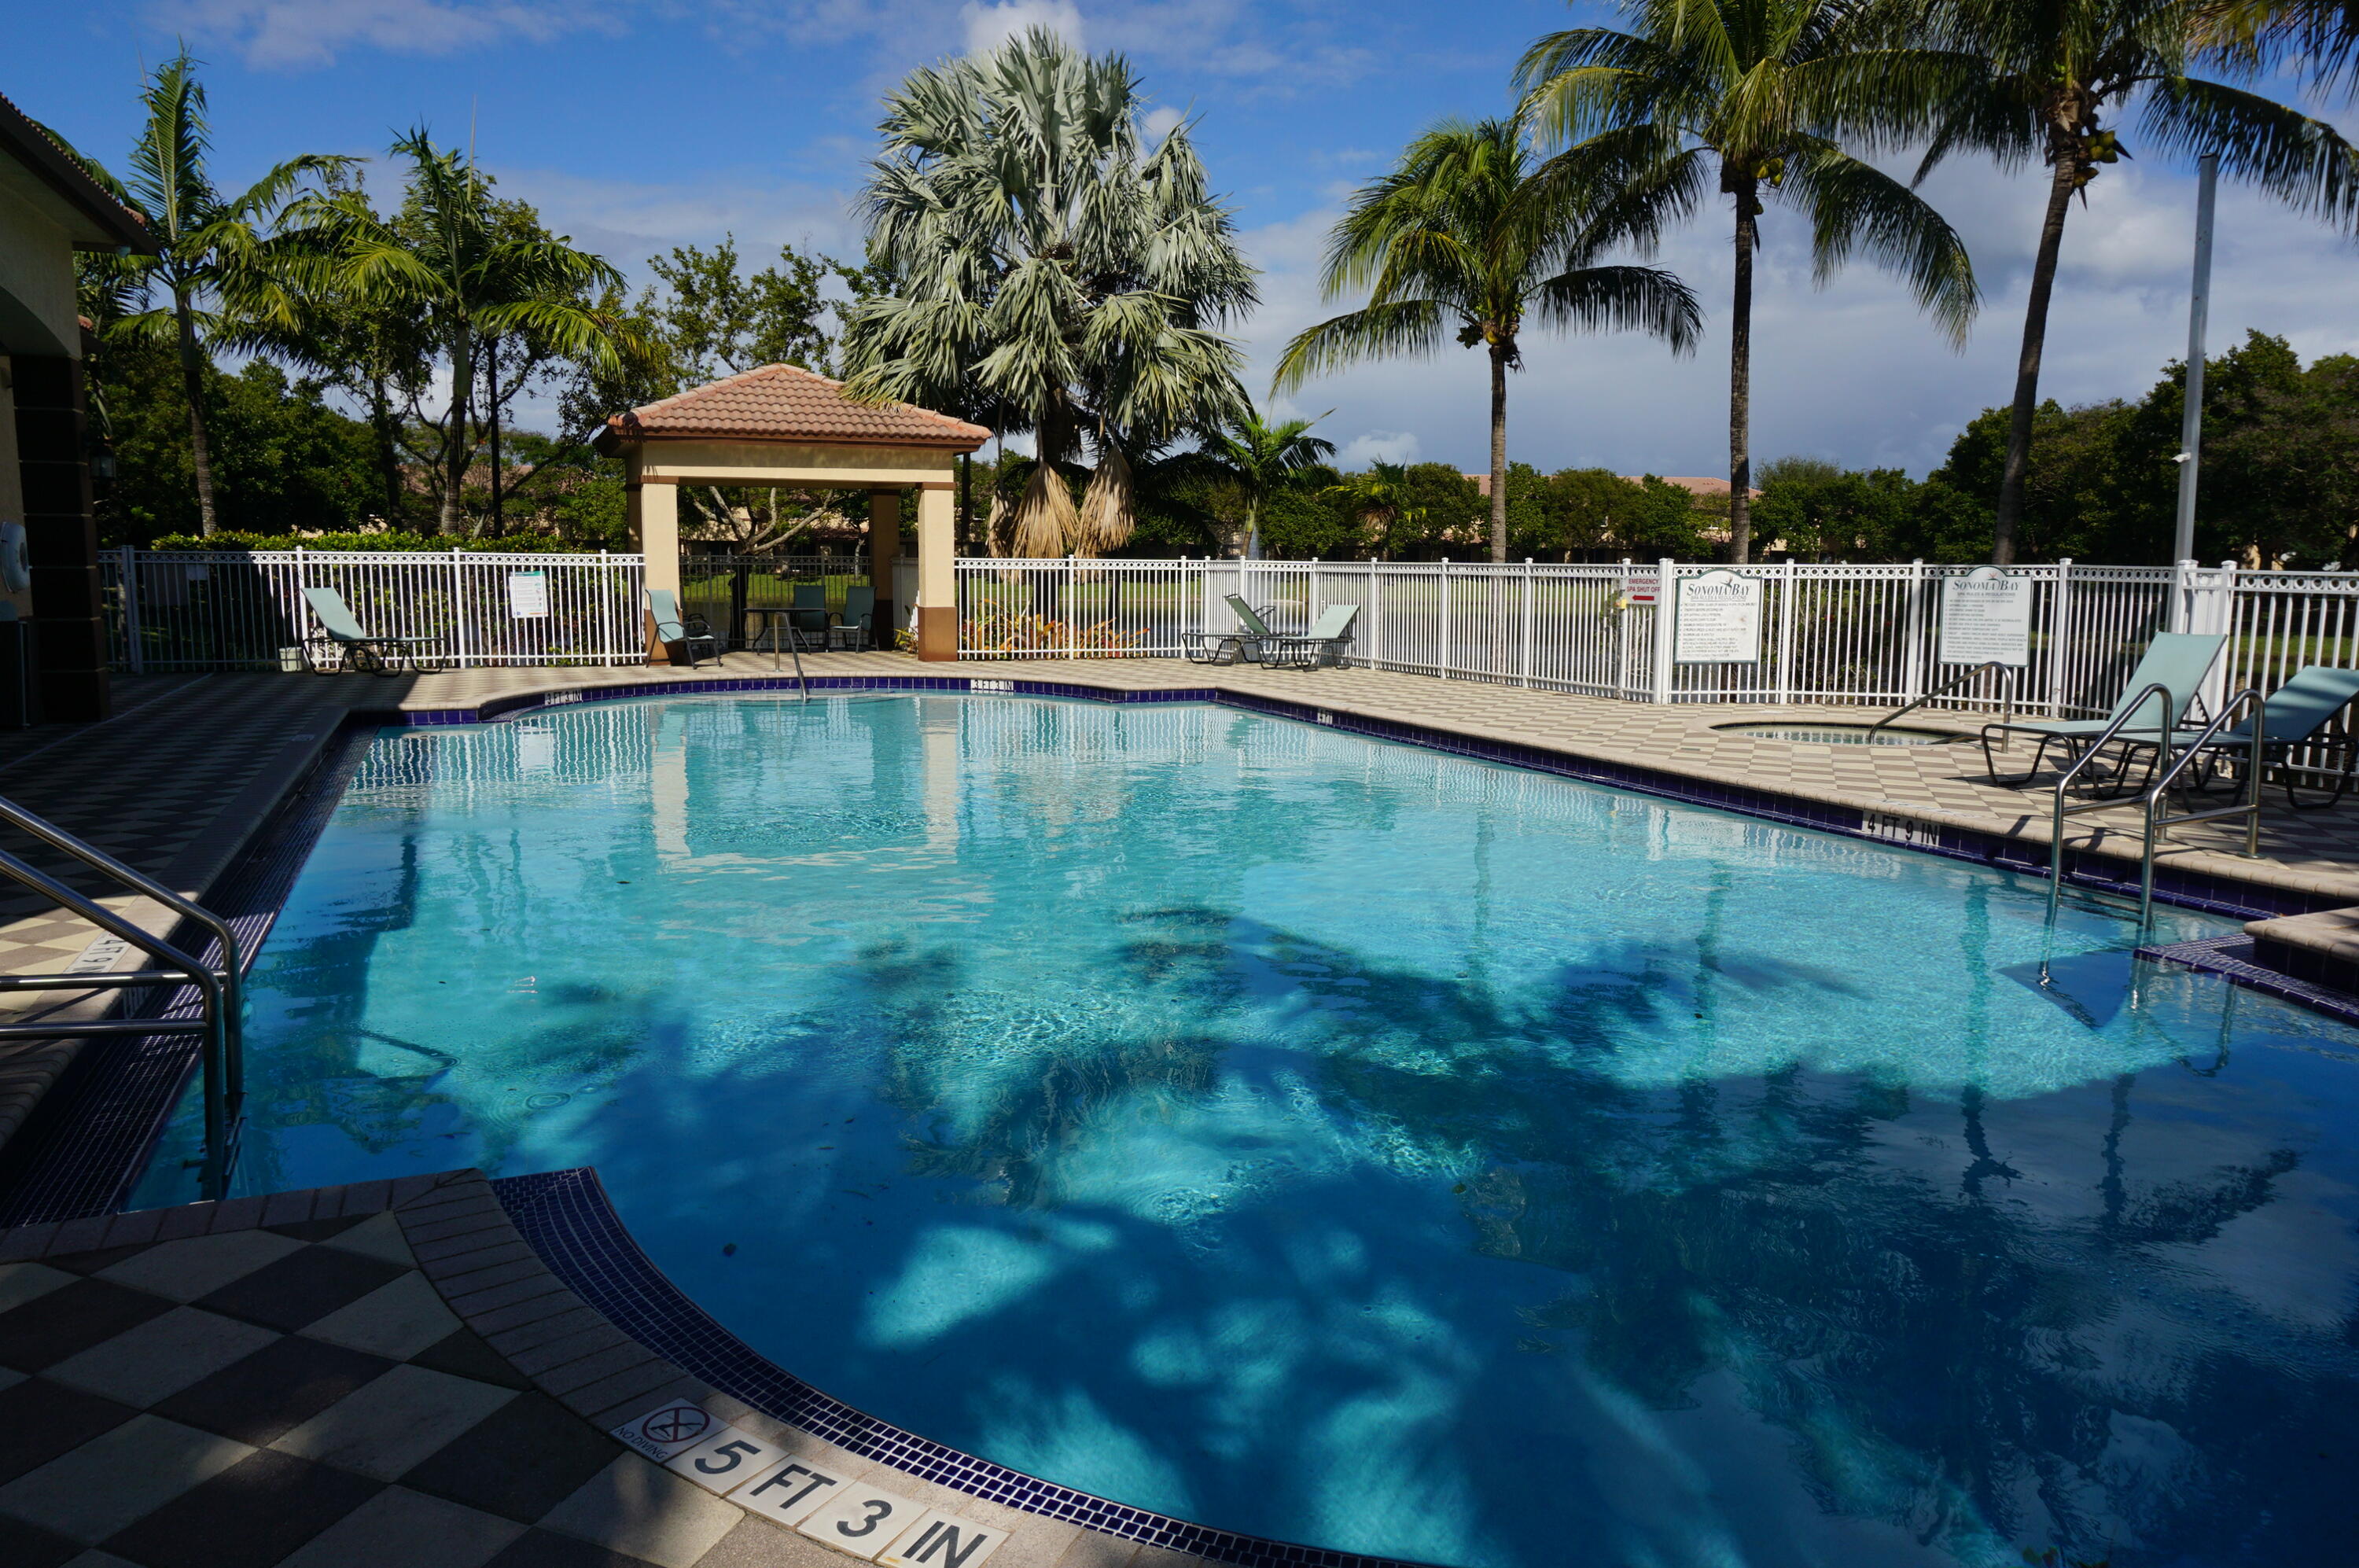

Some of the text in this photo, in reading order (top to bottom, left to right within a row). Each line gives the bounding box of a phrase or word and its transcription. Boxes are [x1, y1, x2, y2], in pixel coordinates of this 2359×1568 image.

[1687, 584, 1751, 596] SONOMA BAY
[1952, 580, 2021, 591] SONOMA BAY
[547, 690, 581, 704] 3 FT 3 IN
[1868, 813, 1938, 845] 4 FT 9 IN
[613, 1426, 669, 1461] NO DIVING
[694, 1440, 988, 1568] 5 FT 3 IN
